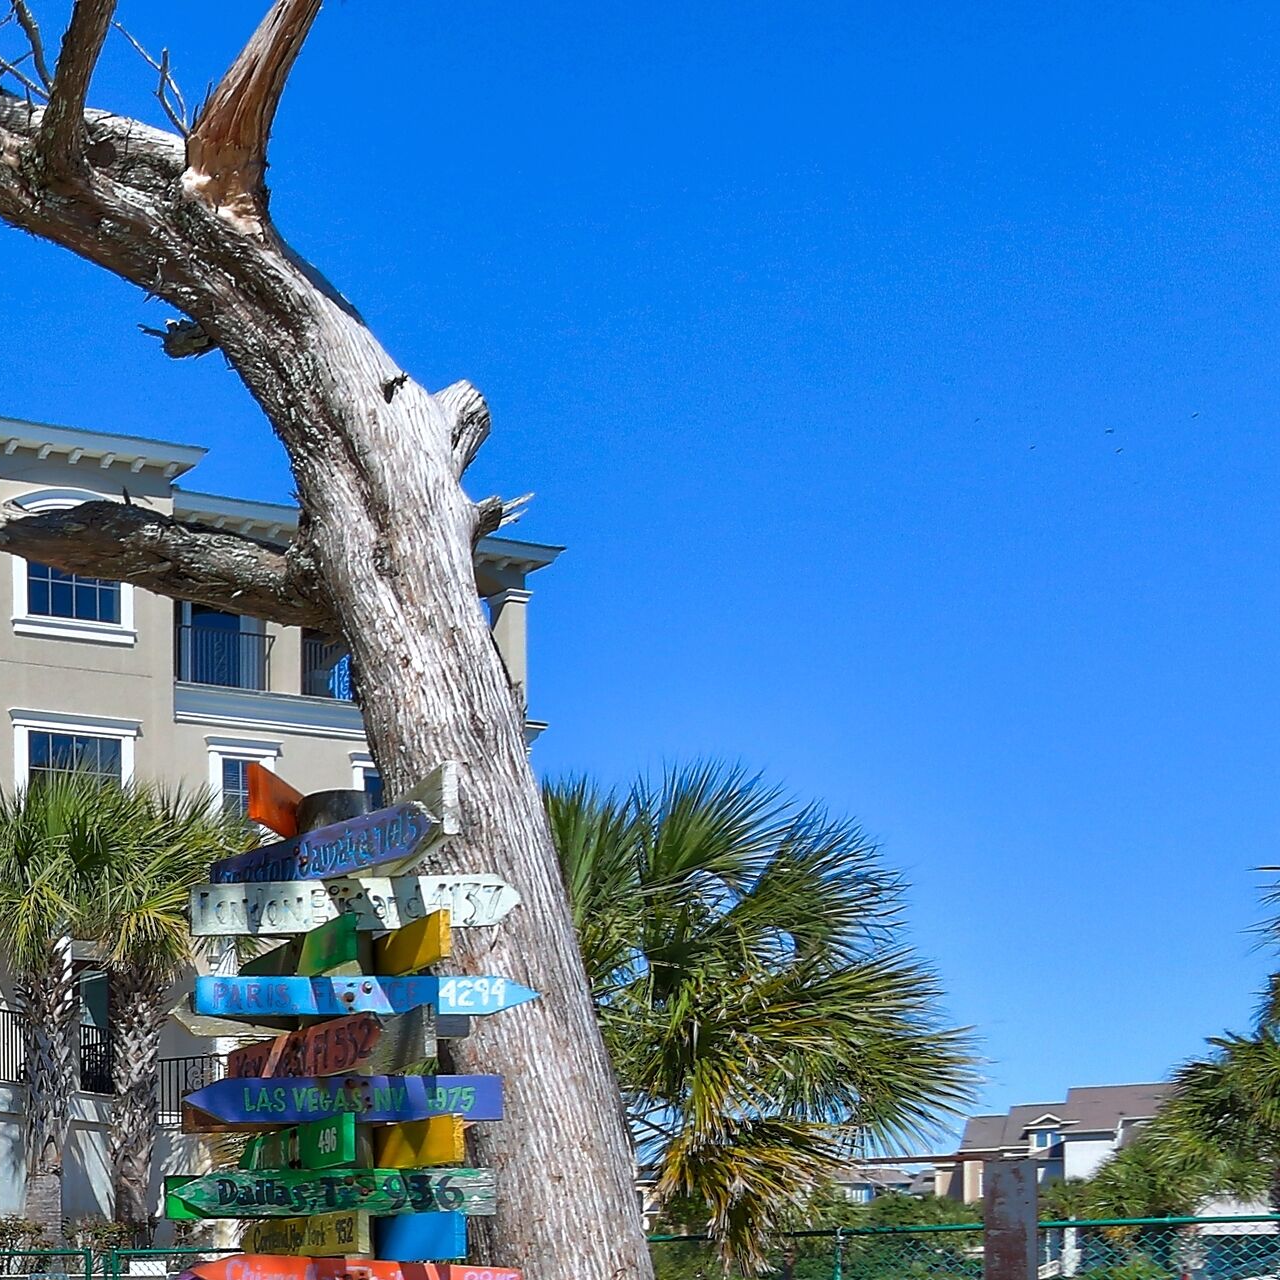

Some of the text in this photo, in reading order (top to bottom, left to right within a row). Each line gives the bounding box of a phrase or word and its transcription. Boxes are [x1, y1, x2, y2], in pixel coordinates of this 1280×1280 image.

[310, 981, 418, 1010] FRCE
[438, 978, 506, 1009] 4294
[242, 1086, 287, 1113] LAS
[373, 1086, 408, 1112] NV
[317, 1126, 338, 1155] 496
[382, 1174, 466, 1211] 936
